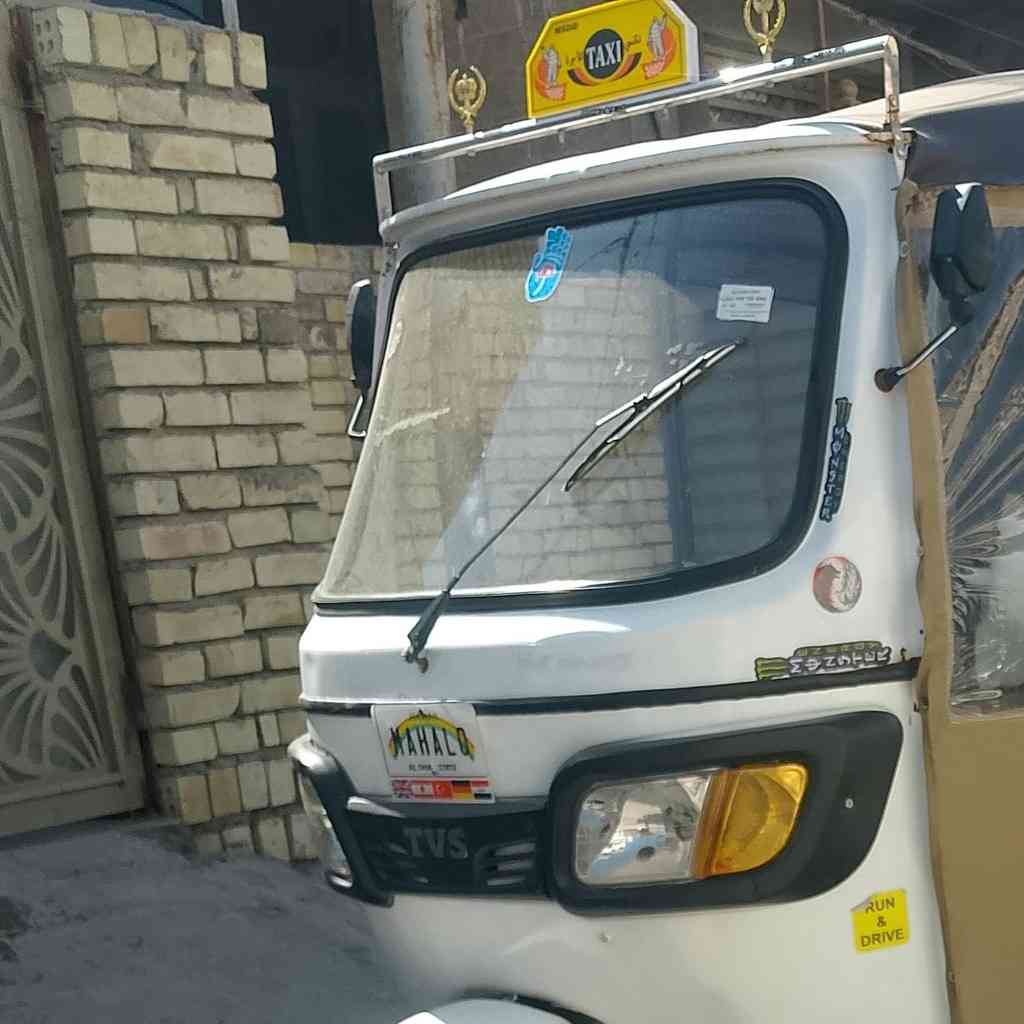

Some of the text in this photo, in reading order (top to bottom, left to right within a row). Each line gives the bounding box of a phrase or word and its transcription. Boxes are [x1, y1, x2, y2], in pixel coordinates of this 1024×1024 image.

[586, 39, 622, 70] TAXI
[390, 727, 470, 757] MAHALO
[403, 826, 468, 859] TVS
[865, 897, 896, 913] RUN
[876, 916, 887, 928] &
[860, 928, 905, 947] DRIVE
